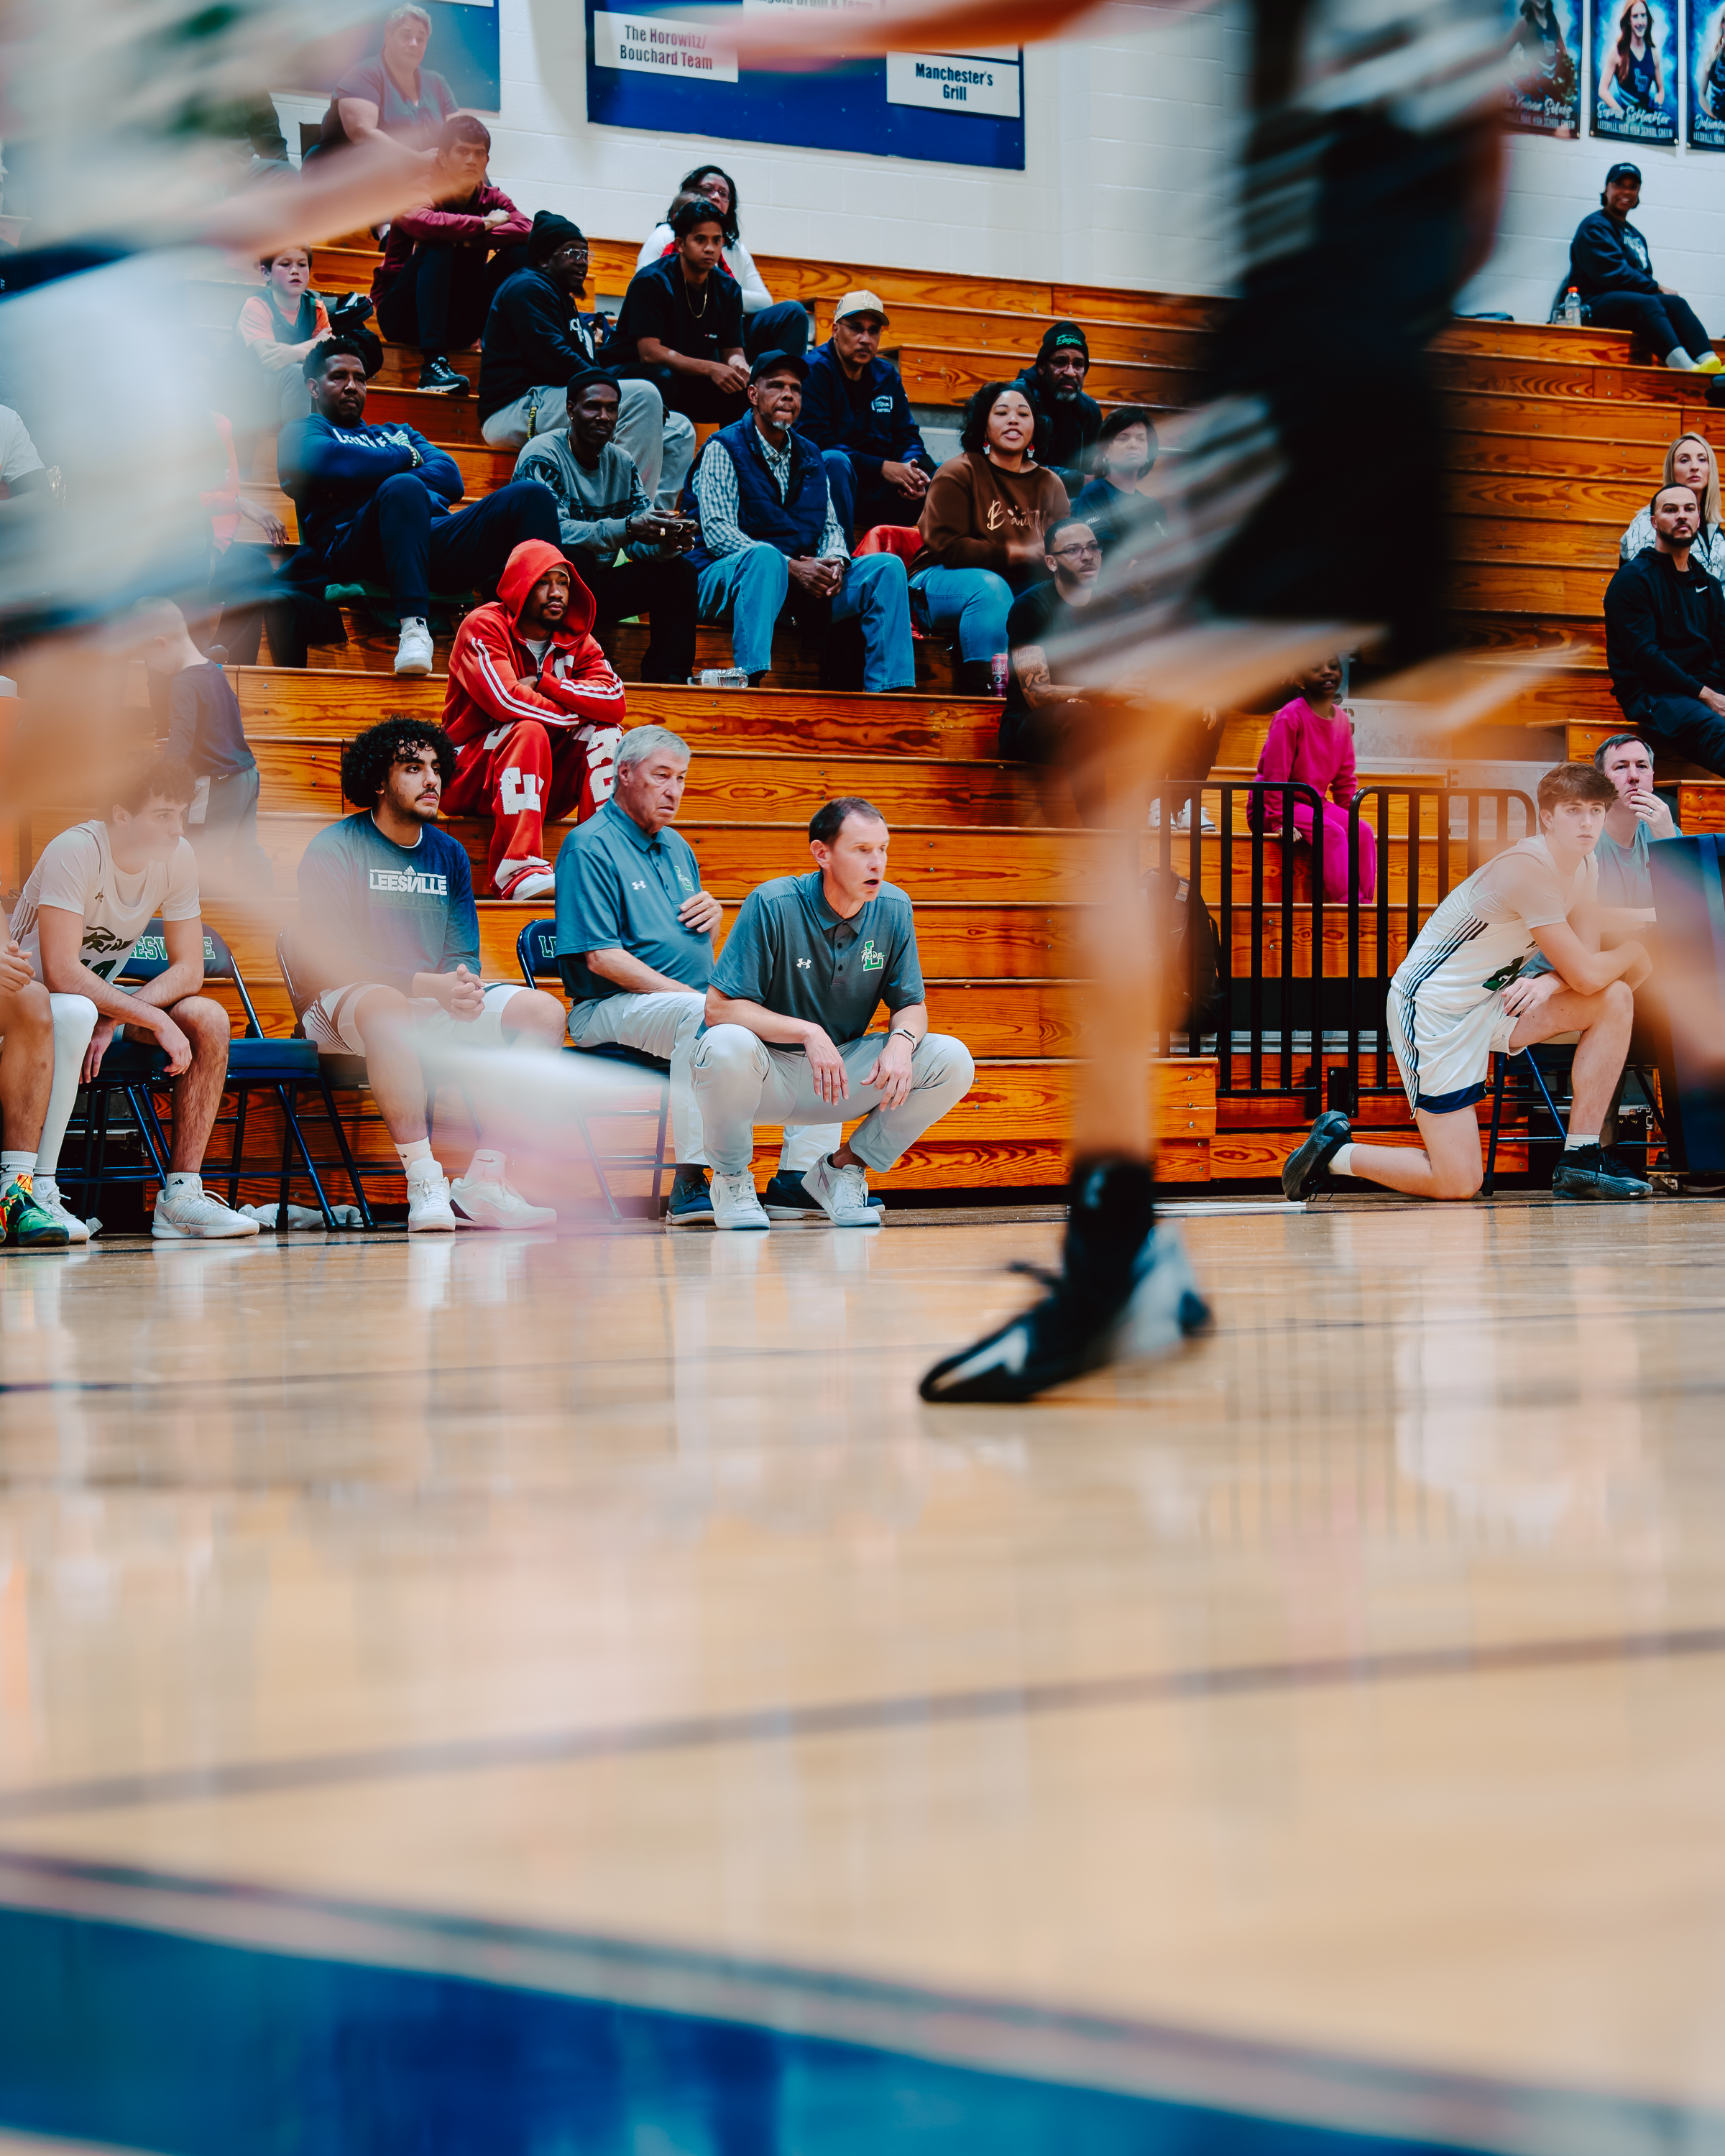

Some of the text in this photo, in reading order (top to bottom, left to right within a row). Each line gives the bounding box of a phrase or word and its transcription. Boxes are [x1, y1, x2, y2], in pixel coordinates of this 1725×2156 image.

[625, 24, 707, 50] The Horowitz/
[620, 45, 712, 70] Bouchard Team
[916, 63, 993, 86] Manchester's
[943, 84, 967, 101] Grill
[862, 292, 874, 308] LA
[1057, 334, 1082, 346] Eagles
[369, 872, 448, 896] LEESVILLE
